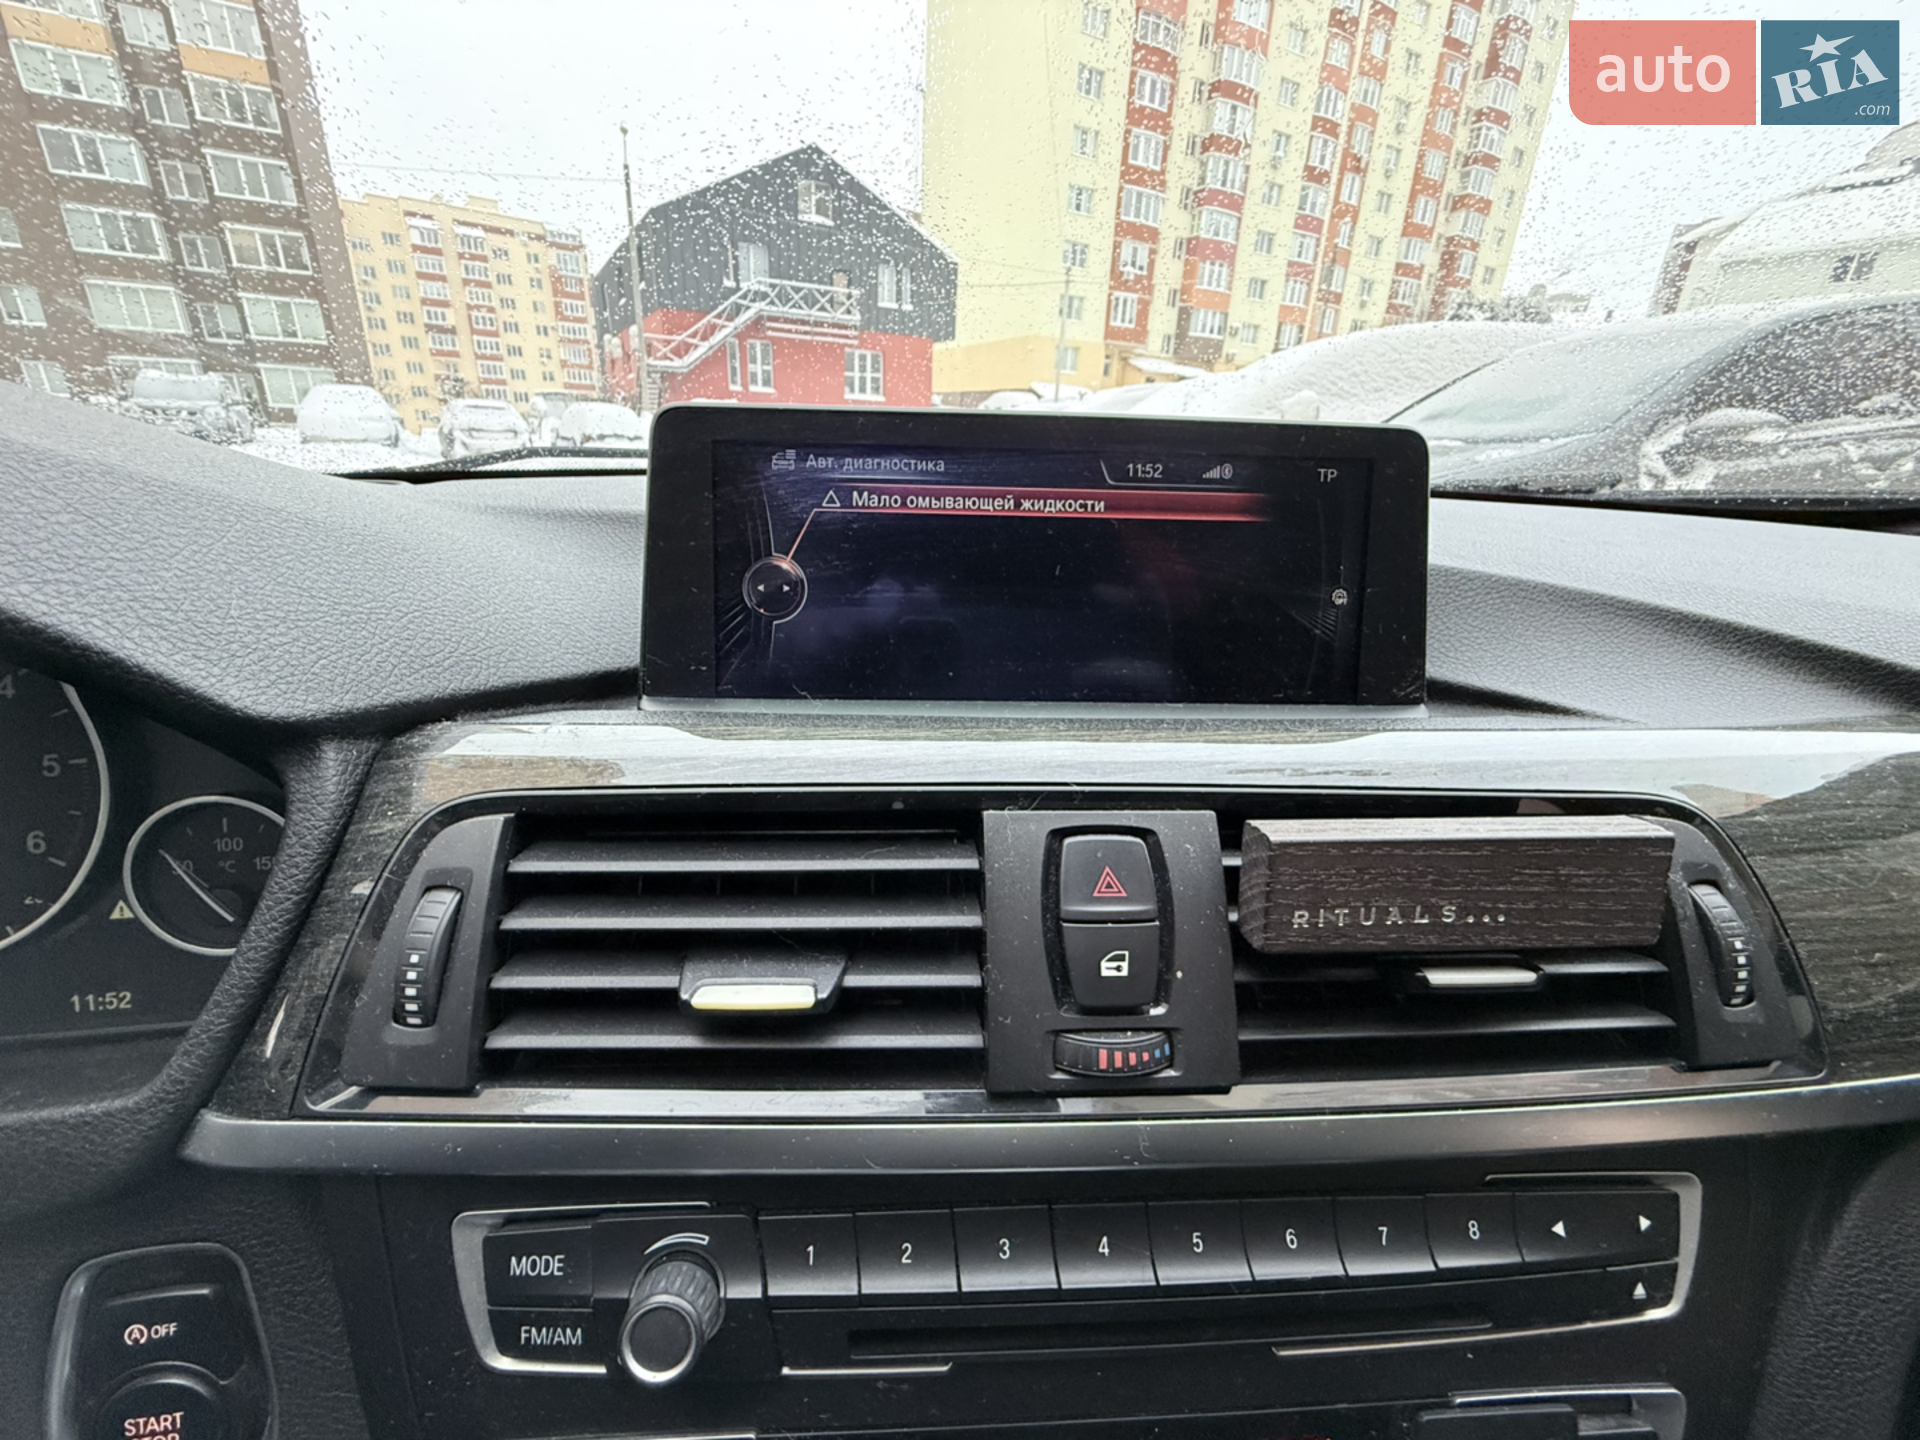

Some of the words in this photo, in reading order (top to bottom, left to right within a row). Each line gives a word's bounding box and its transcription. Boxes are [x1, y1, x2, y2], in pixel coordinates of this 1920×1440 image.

[805, 454, 838, 469] Авт.
[843, 457, 945, 472] диагностика
[1127, 463, 1163, 479] 11:52
[852, 490, 901, 508] Мало
[906, 491, 1015, 512] омывающей
[1020, 496, 1105, 514] жидкости
[42, 754, 61, 778] 5
[26, 830, 47, 855] 6
[213, 837, 244, 852] 100
[253, 856, 276, 871] 15
[1292, 904, 1506, 929] RITUALS...
[70, 990, 132, 1013] 11:52
[1285, 1228, 1298, 1249] 6
[1378, 1226, 1388, 1246] 7
[1468, 1219, 1480, 1240] 8
[901, 1242, 912, 1264] 2
[999, 1238, 1010, 1260] 3
[1098, 1235, 1110, 1257] 4
[1192, 1232, 1203, 1253] 5
[510, 1254, 565, 1277] MODE
[806, 1245, 815, 1266] 1
[150, 1322, 178, 1339] OFF
[520, 1325, 582, 1346] FM/AM
[124, 1411, 184, 1437] START
